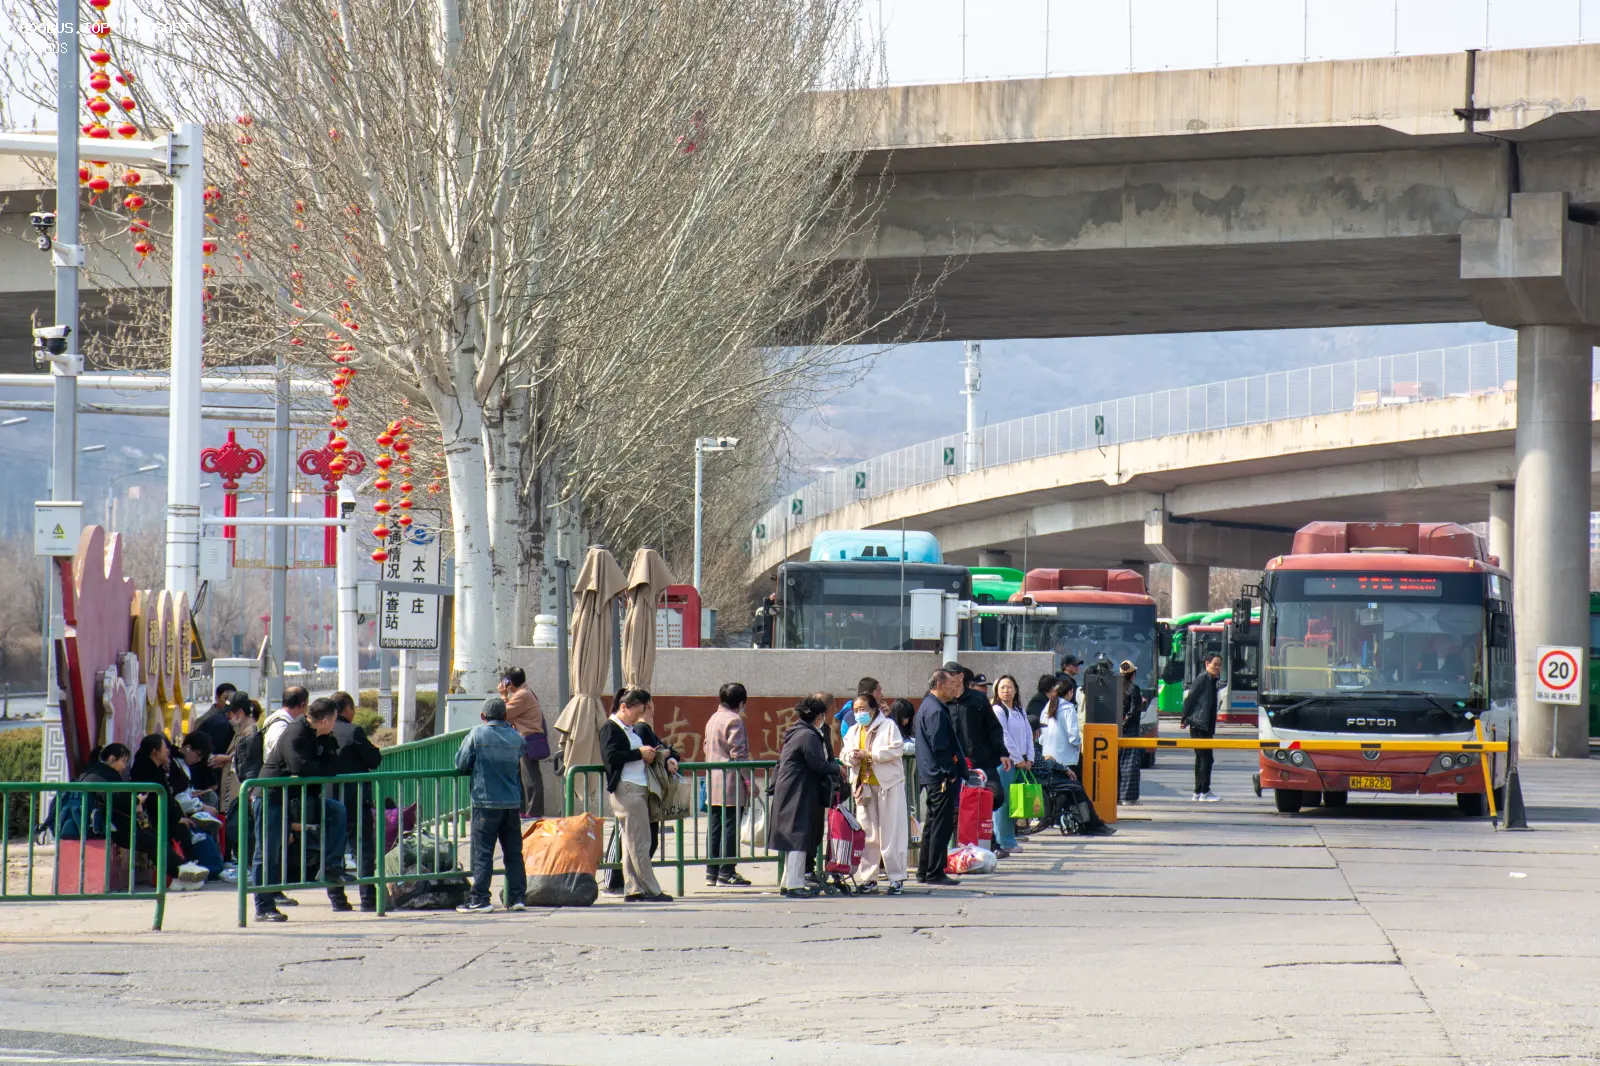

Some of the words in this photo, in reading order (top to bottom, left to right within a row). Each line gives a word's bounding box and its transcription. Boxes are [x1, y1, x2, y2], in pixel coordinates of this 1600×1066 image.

[1548, 661, 1569, 679] 20
[1346, 718, 1397, 726] FOTON
[1093, 737, 1109, 759] P
